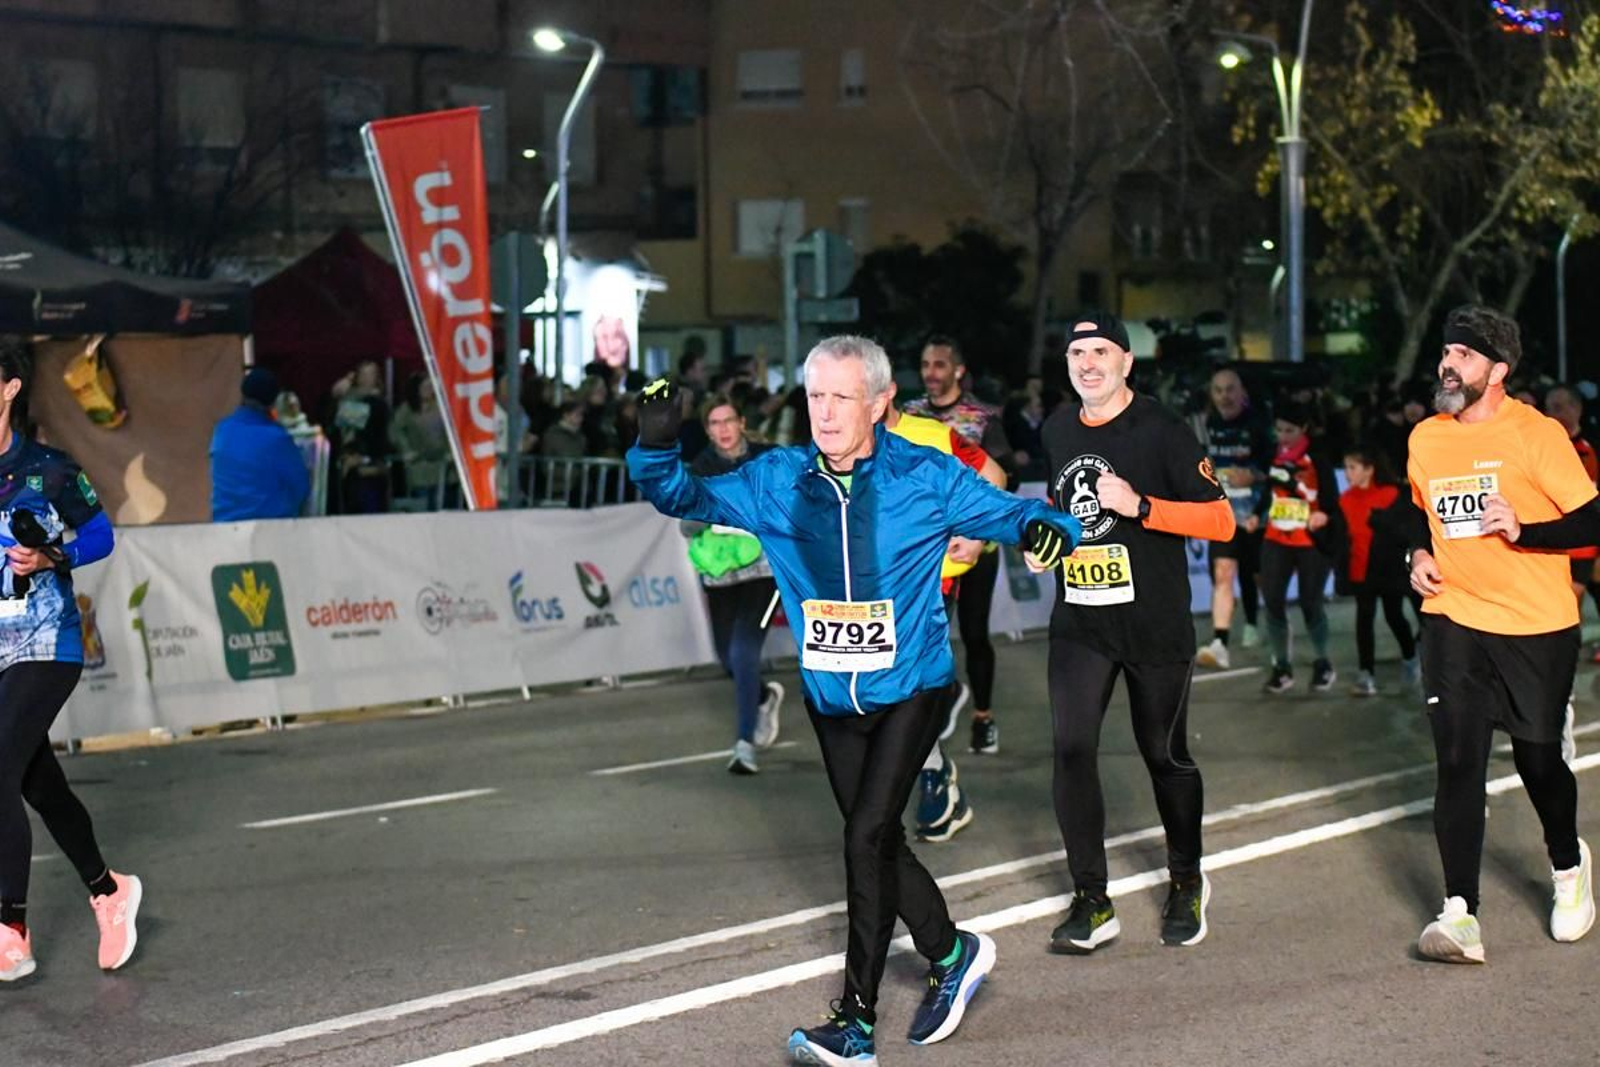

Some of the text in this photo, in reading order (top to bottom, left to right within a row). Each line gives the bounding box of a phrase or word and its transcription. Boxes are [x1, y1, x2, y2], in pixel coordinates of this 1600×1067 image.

[1073, 502, 1097, 516] GAB
[1067, 562, 1123, 584] 4108
[628, 575, 679, 608] alsa
[305, 596, 397, 627] calderón
[812, 620, 886, 645] 9792
